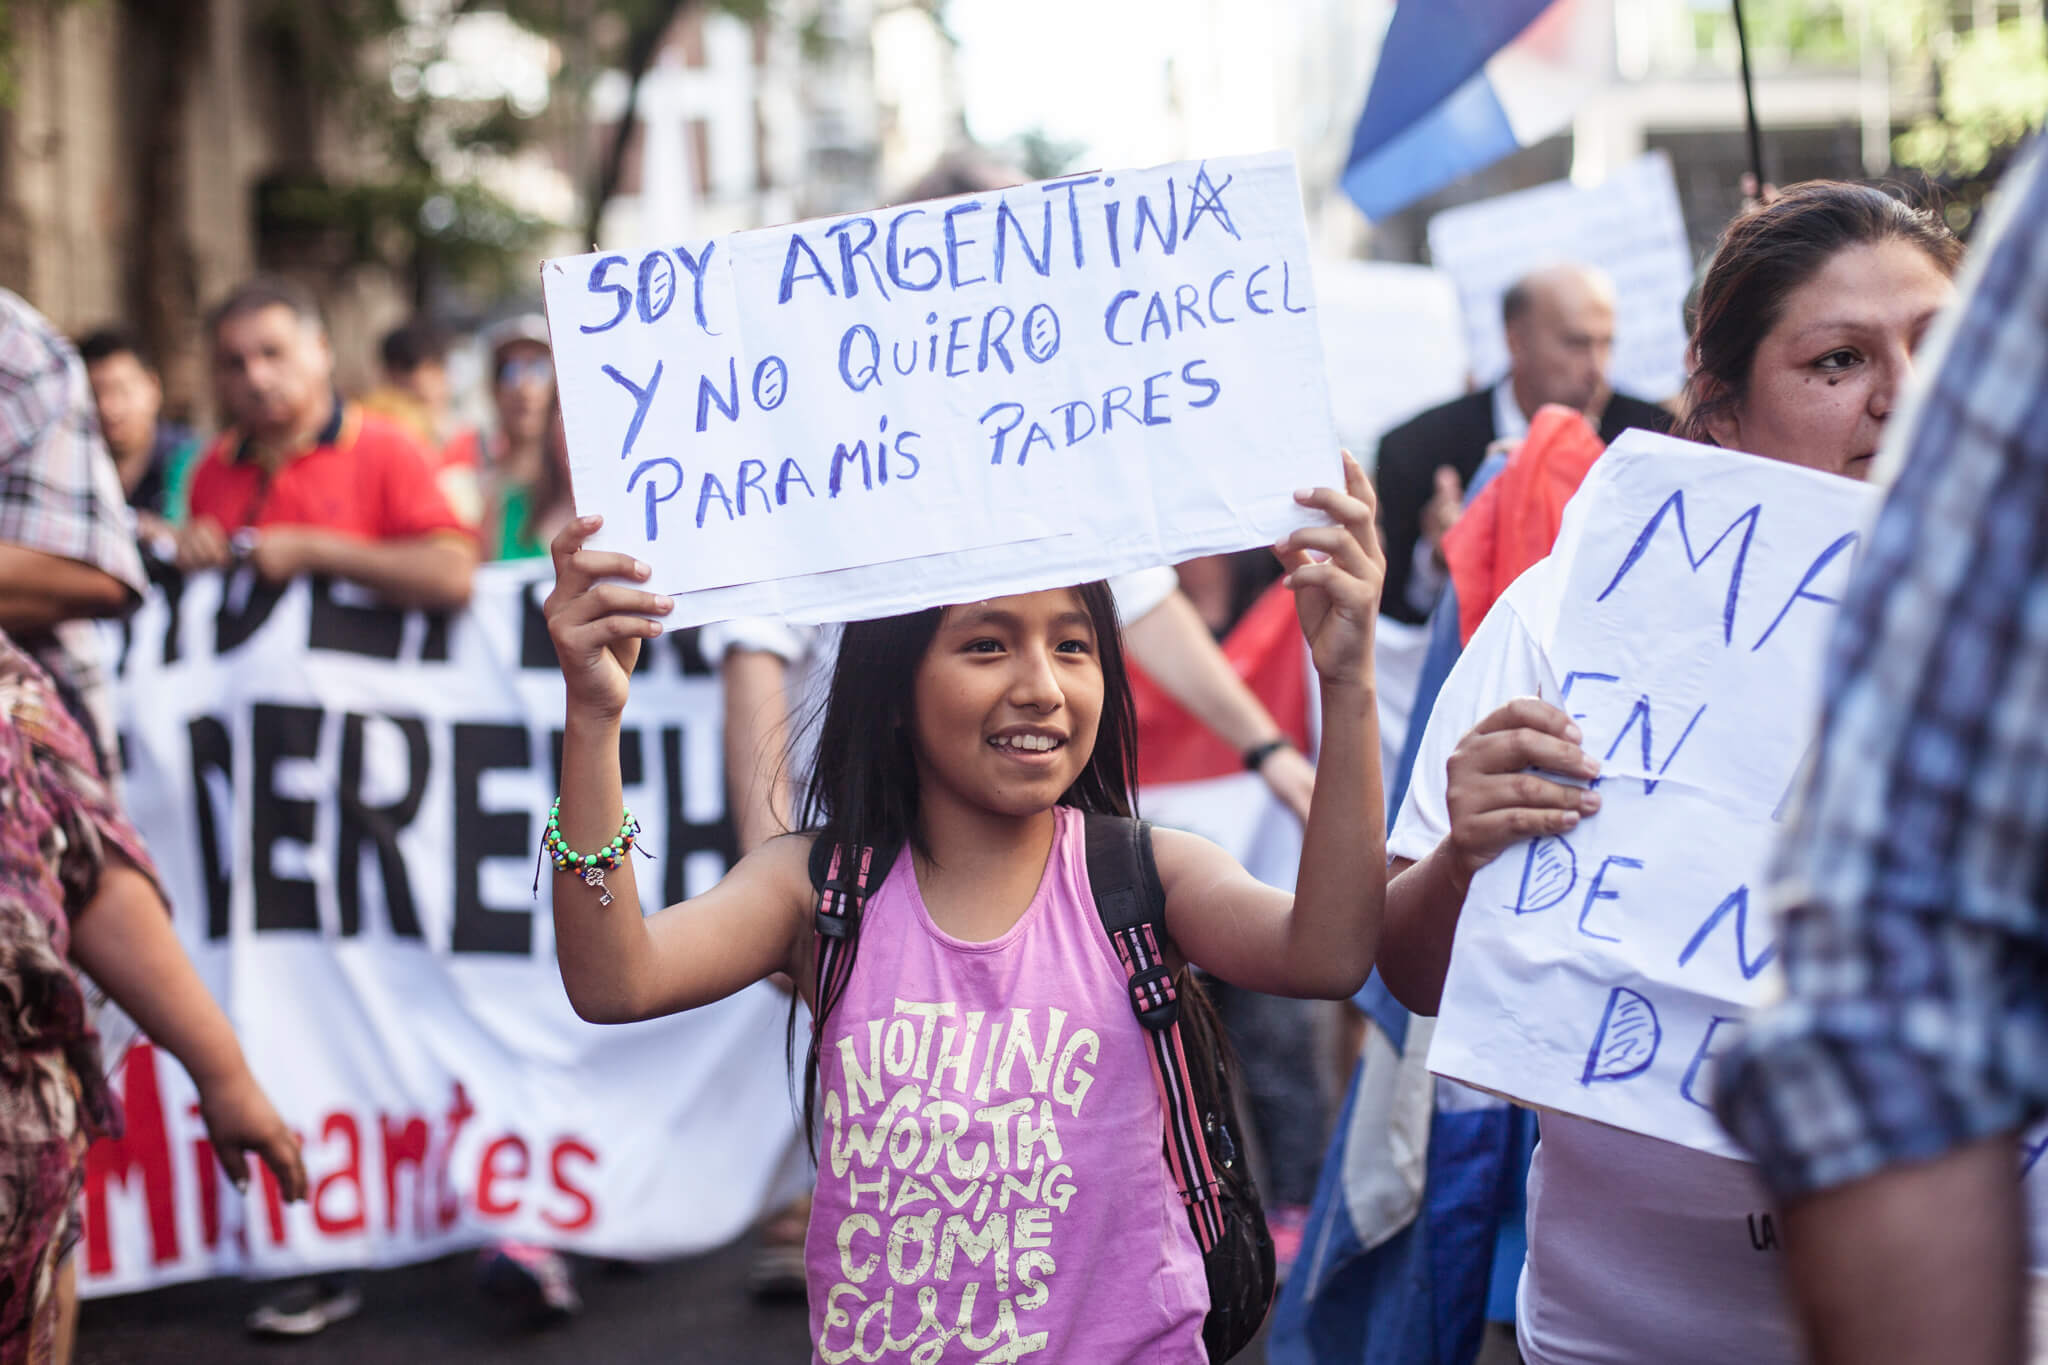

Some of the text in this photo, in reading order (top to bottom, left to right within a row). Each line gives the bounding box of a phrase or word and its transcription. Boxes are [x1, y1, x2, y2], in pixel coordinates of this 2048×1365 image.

[579, 240, 722, 336] SOY
[600, 359, 663, 461] Y
[695, 354, 788, 432] NO
[1103, 261, 1307, 346] CARCEL
[978, 360, 1221, 467] PADRES
[1502, 834, 1646, 944] DE
[835, 998, 1101, 1118] NOTHING
[824, 1085, 1063, 1180] WORTH
[836, 1207, 1057, 1310] COMES
